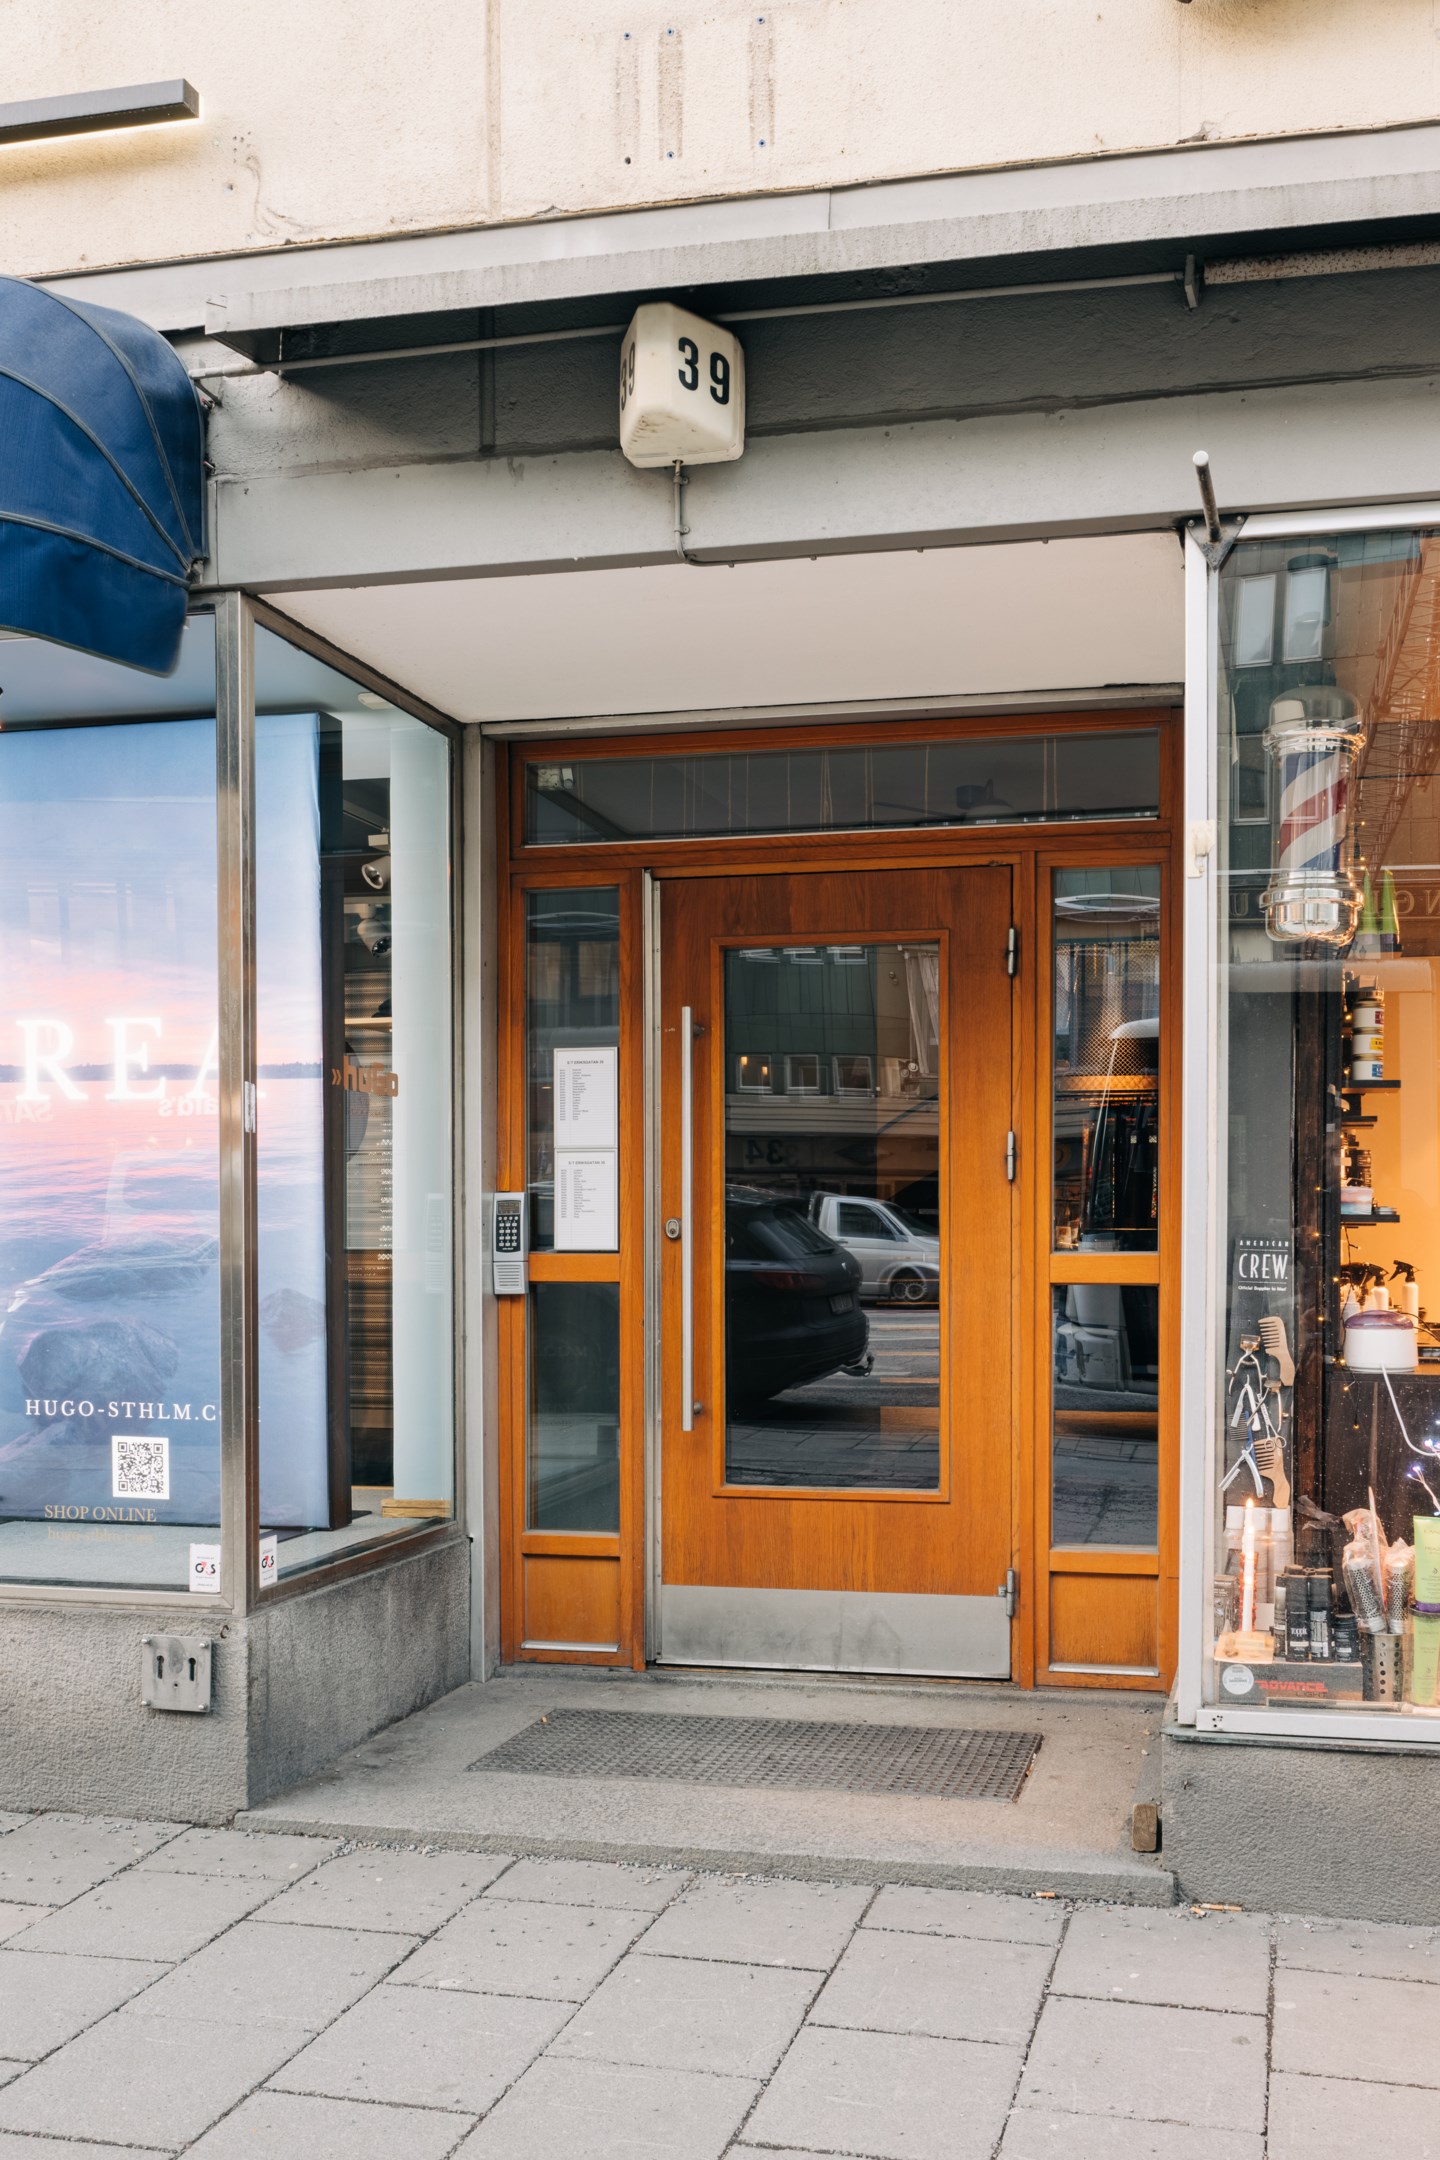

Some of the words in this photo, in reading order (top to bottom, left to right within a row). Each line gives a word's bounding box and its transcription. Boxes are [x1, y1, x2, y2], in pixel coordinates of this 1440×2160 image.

[620, 342, 635, 411] 39
[678, 336, 730, 406] 39
[44, 1504, 89, 1520] SHOP
[92, 1506, 157, 1522] ONLINE
